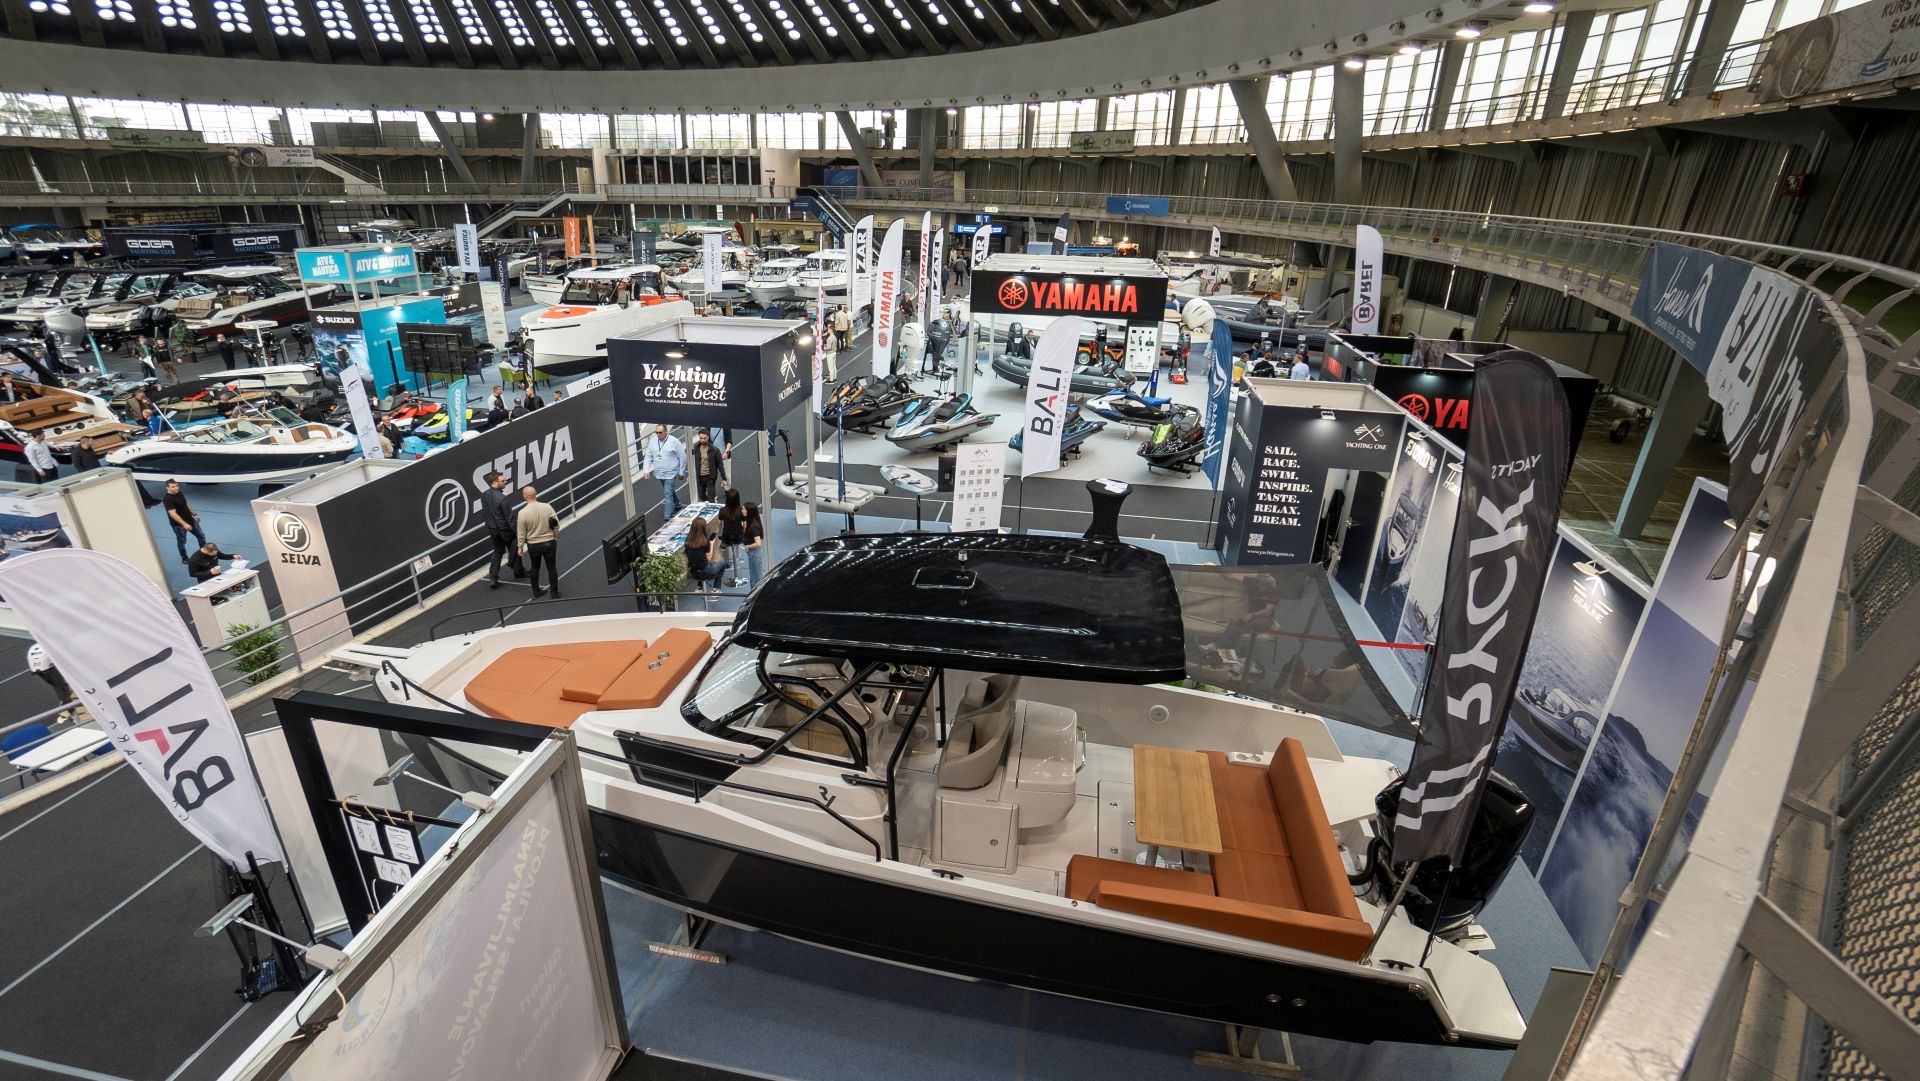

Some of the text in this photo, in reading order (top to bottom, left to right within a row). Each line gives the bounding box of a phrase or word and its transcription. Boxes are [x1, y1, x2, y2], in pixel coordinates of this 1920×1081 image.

[1881, 0, 1911, 18] KURS
[126, 239, 174, 249] GOGA
[232, 235, 280, 247] GOGA
[856, 233, 867, 273] ZAR
[920, 232, 929, 293] YAMAHA
[312, 264, 340, 277] NAUTICA
[1654, 255, 1690, 319] Hanse
[879, 271, 894, 330] YAMAHA
[1031, 281, 1138, 313] YAMAHA
[324, 316, 355, 325] SUZUKI
[641, 363, 726, 389] Yachting
[644, 382, 727, 401] at its best
[1031, 366, 1062, 436] BALI
[1264, 445, 1297, 456] SAIL.
[1345, 442, 1373, 450] YACHTING
[473, 425, 575, 514] SELVA
[1263, 457, 1301, 469] RACE.
[1260, 469, 1299, 481] SWIM.
[1259, 481, 1313, 493] INSPIRE.
[1257, 492, 1300, 504] TASTE.
[1254, 504, 1301, 515] RELAX.
[1253, 515, 1301, 527] DREAM.
[281, 553, 321, 567] SELVA
[1573, 594, 1603, 624] SEALINE
